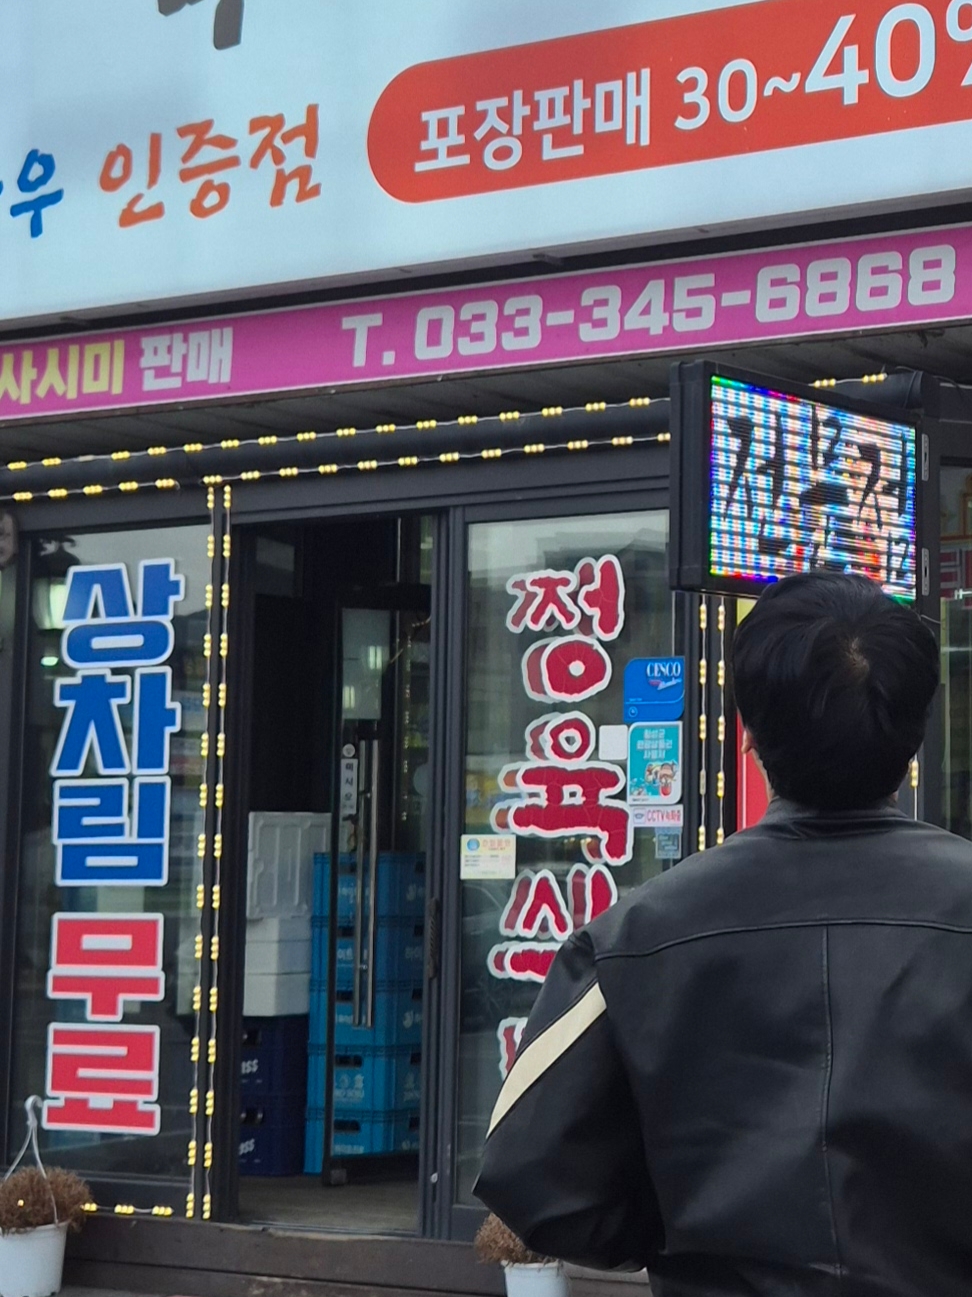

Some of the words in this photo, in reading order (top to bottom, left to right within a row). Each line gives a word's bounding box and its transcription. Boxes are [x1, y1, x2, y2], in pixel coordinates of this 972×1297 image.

[0, 148, 64, 238] 우
[98, 103, 321, 228] 인증점
[413, 68, 651, 173] 포장판매
[0, 338, 125, 405] 사시미
[139, 327, 234, 392] 판매
[341, 312, 396, 368] T.
[413, 243, 956, 361] 033-345-6868
[50, 558, 184, 887] 상차림
[646, 661, 681, 677] CESCO
[495, 555, 635, 1079] 정육식
[42, 912, 165, 1136] 무료
